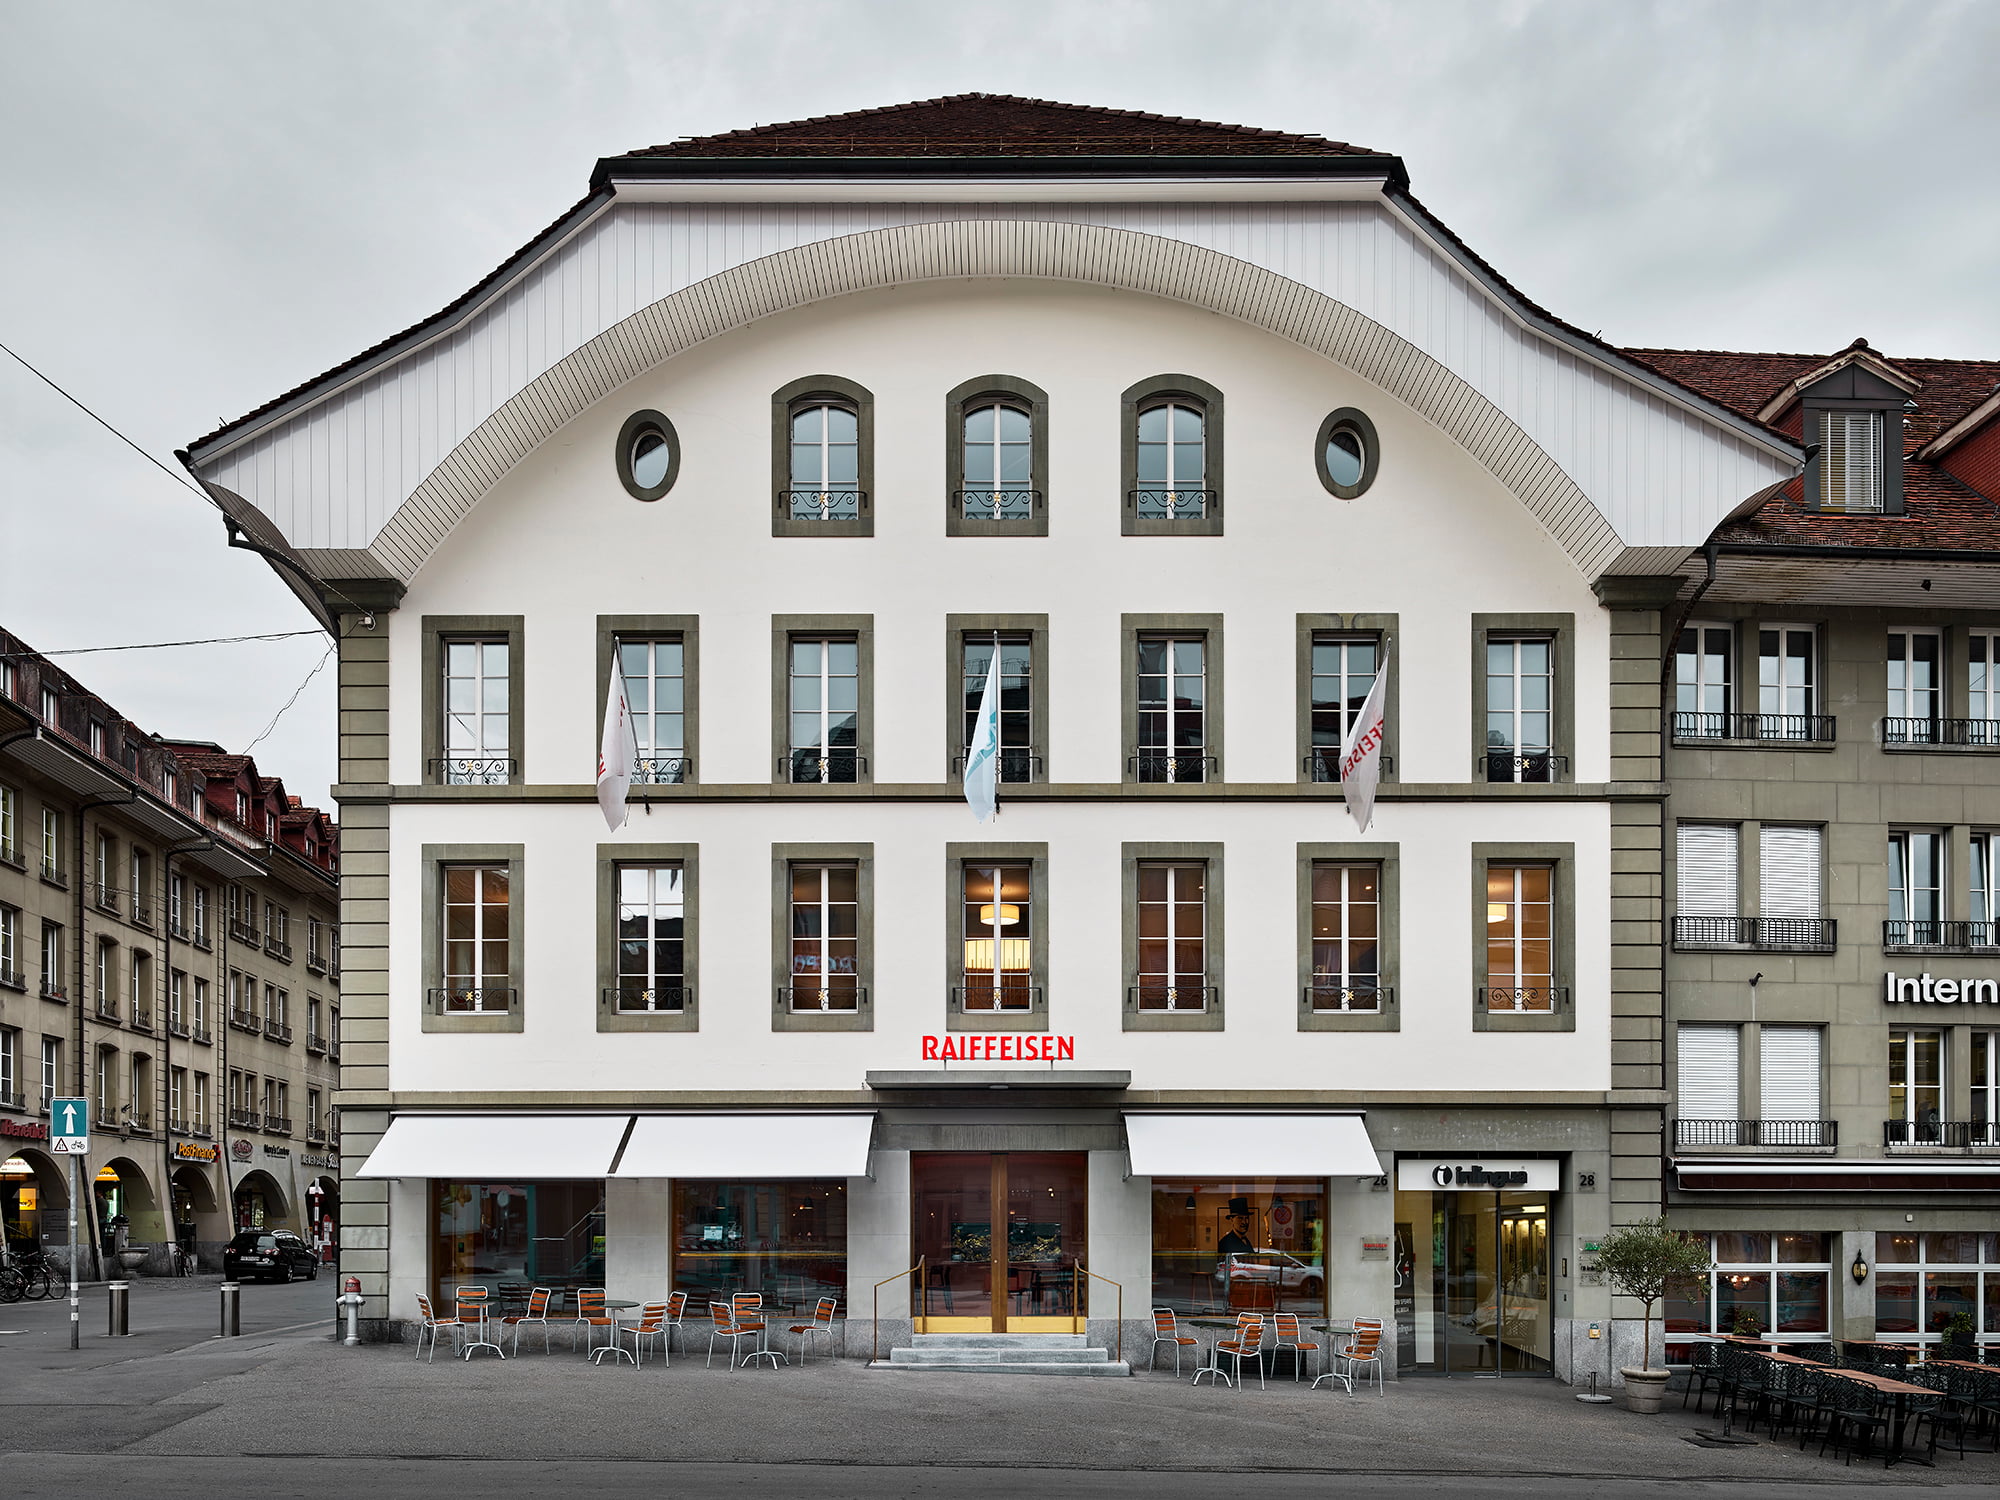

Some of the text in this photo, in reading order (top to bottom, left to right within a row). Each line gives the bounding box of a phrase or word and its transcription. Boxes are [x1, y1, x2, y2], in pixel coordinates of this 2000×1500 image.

[1887, 972, 1999, 1004] Intern
[922, 1035, 1075, 1061] RAIFFEISEN
[178, 1142, 216, 1160] PostFinance
[1372, 1174, 1389, 1187] 26
[1455, 1165, 1528, 1188] inlingua
[1579, 1174, 1596, 1187] 28
